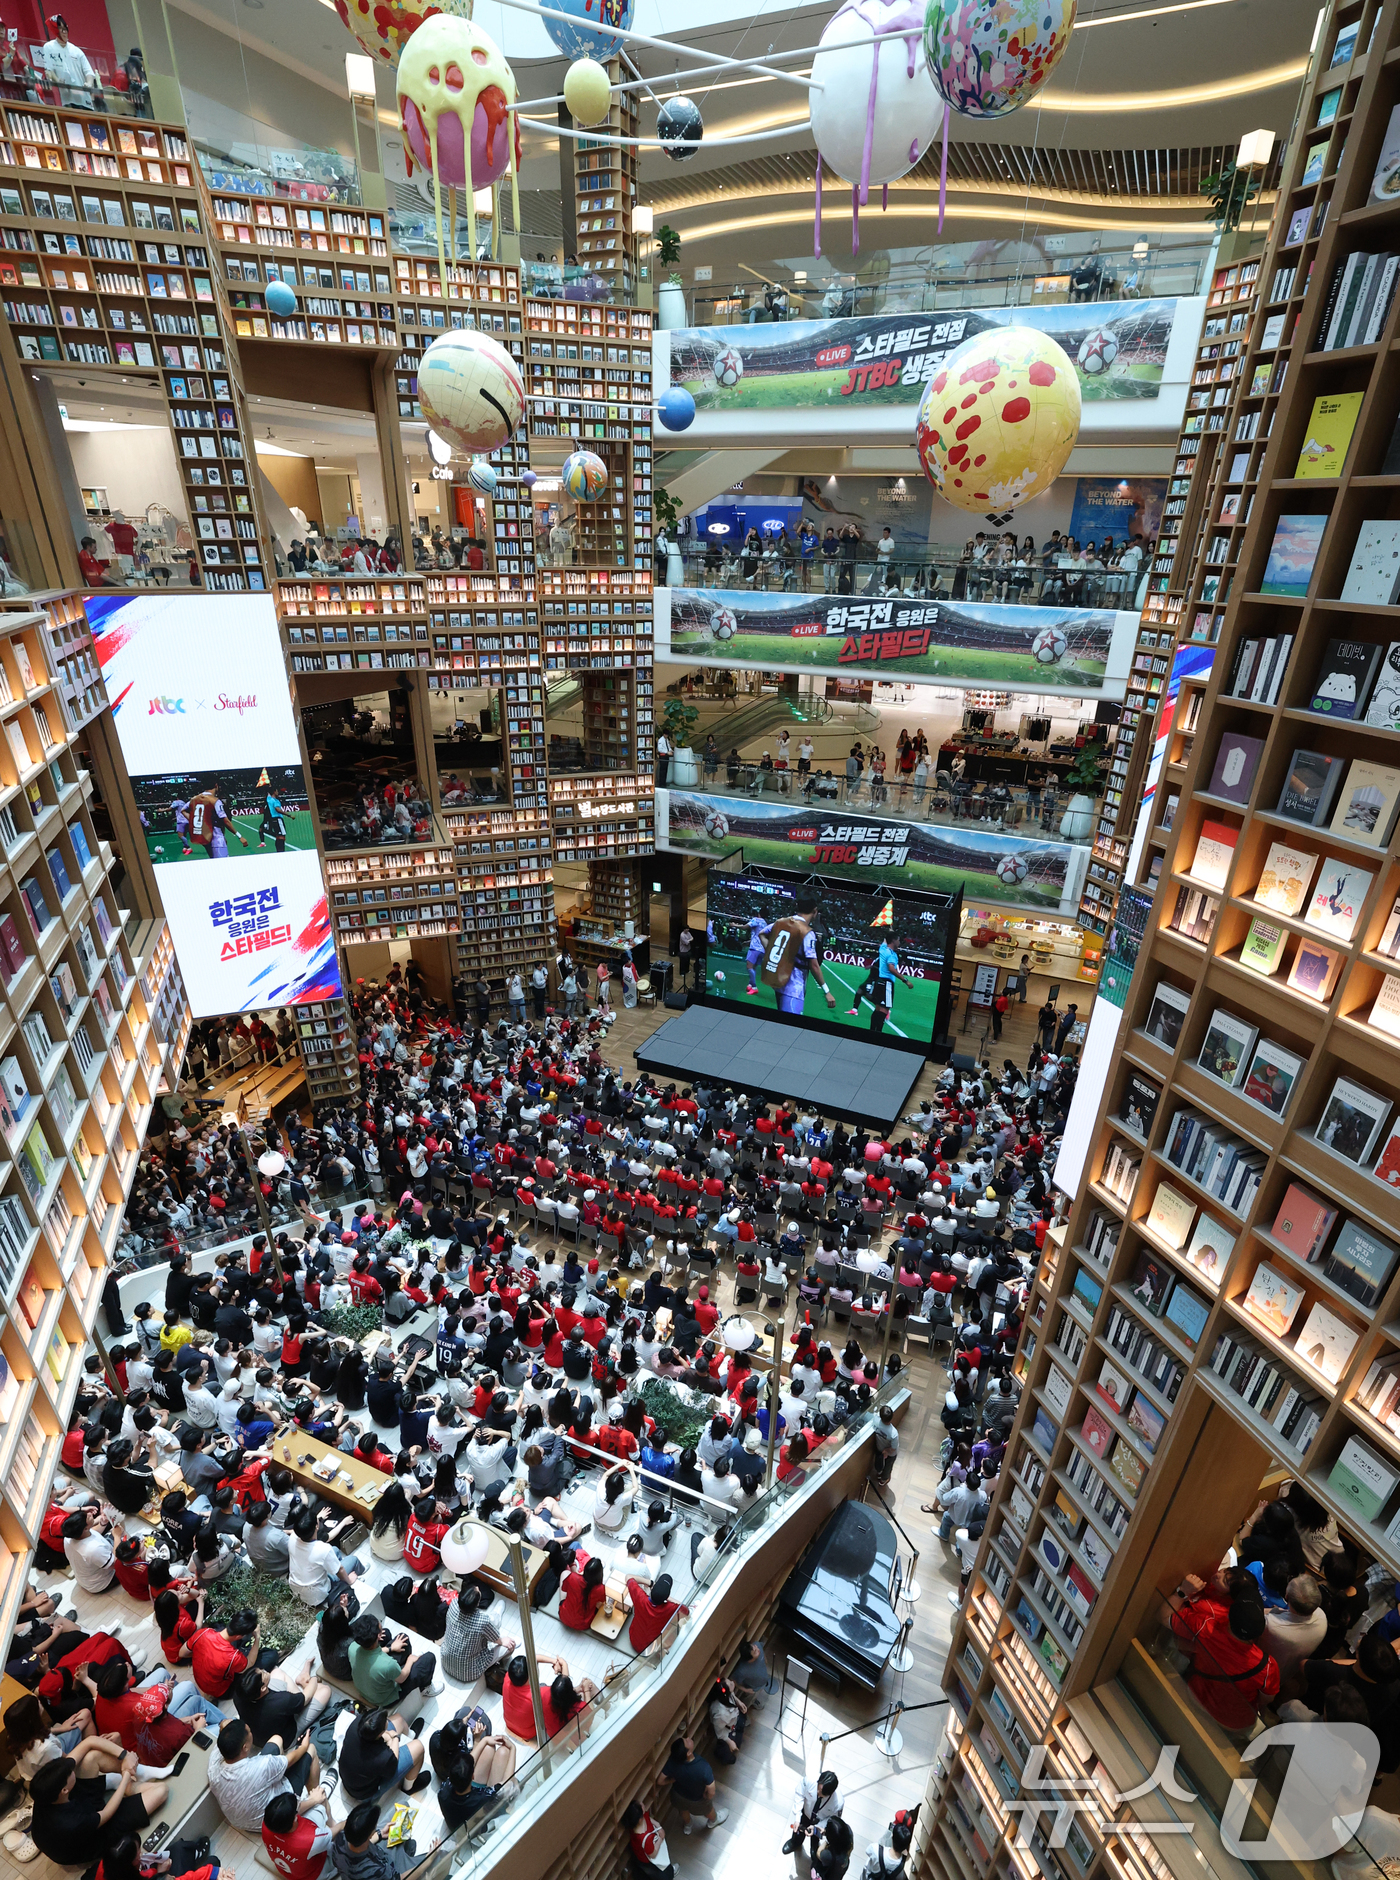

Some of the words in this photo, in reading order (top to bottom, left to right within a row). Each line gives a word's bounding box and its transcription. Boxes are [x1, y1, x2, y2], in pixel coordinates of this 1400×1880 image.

[854, 326, 931, 361] 스타필드
[931, 318, 968, 345] 전점
[826, 348, 847, 362] LIVE
[841, 359, 902, 395] JTBC
[902, 349, 956, 386] 생중
[1088, 490, 1122, 498] BEYOND
[800, 625, 819, 636] LIVE
[825, 602, 894, 634] 한국전
[895, 607, 939, 626] 응원은
[837, 629, 930, 663] 스타필드!
[148, 695, 186, 716] jtbc
[213, 693, 258, 716] Starfield
[231, 807, 260, 817] QATAR
[578, 800, 635, 818] 별마당도서관
[796, 829, 815, 838] LIVE
[819, 825, 880, 844] 스타필드
[881, 827, 909, 843] 전점
[808, 845, 858, 865] JTBC
[857, 846, 908, 867] 생중계
[208, 886, 283, 927] 한국전
[228, 915, 269, 938] 응원은
[219, 924, 292, 962] 스타필드!
[823, 950, 865, 967] QATAR
[462, 1143, 470, 1155] 8
[808, 1137, 821, 1148] 24
[498, 1150, 504, 1163] 4
[439, 1346, 452, 1364] 19
[405, 1528, 424, 1559] 19
